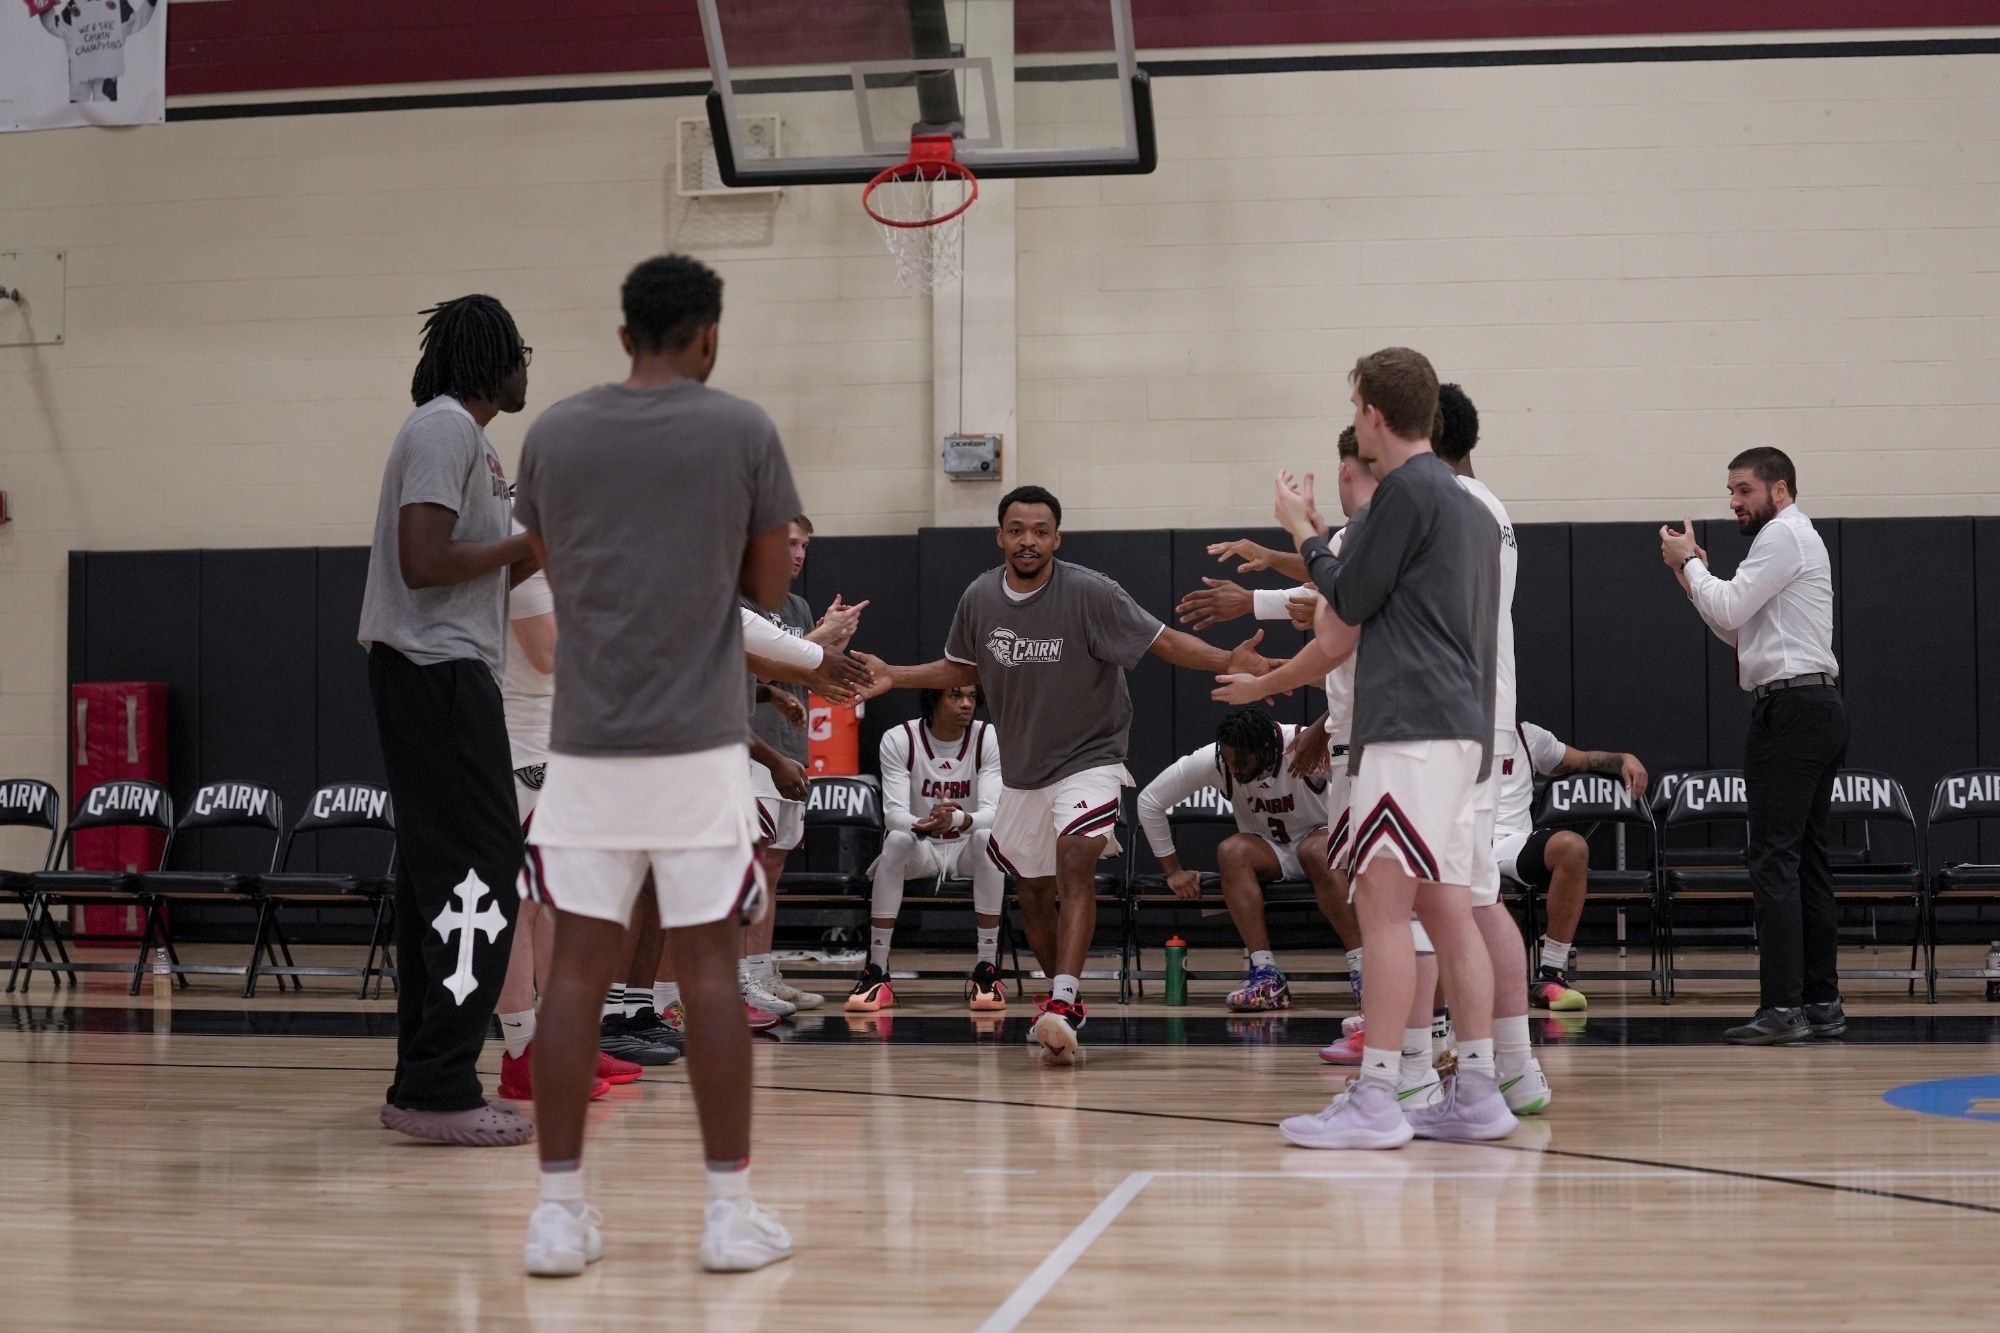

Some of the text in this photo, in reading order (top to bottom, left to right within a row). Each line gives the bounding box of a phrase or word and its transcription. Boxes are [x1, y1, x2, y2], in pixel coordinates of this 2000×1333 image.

[1013, 641, 1060, 660] CAIRN
[808, 707, 832, 741] G
[0, 784, 48, 814] AIRN
[87, 785, 161, 818] CAIRN
[195, 785, 269, 816] CAIRN
[313, 787, 388, 819] CAIRN
[807, 784, 867, 817] AIRN
[1165, 785, 1234, 815] AIRN
[1552, 777, 1632, 811] CAIRN
[1686, 776, 1748, 811] CAIR
[1830, 775, 1891, 810] AIRN
[1947, 775, 2000, 809] CAI
[1267, 816, 1292, 845] 3
